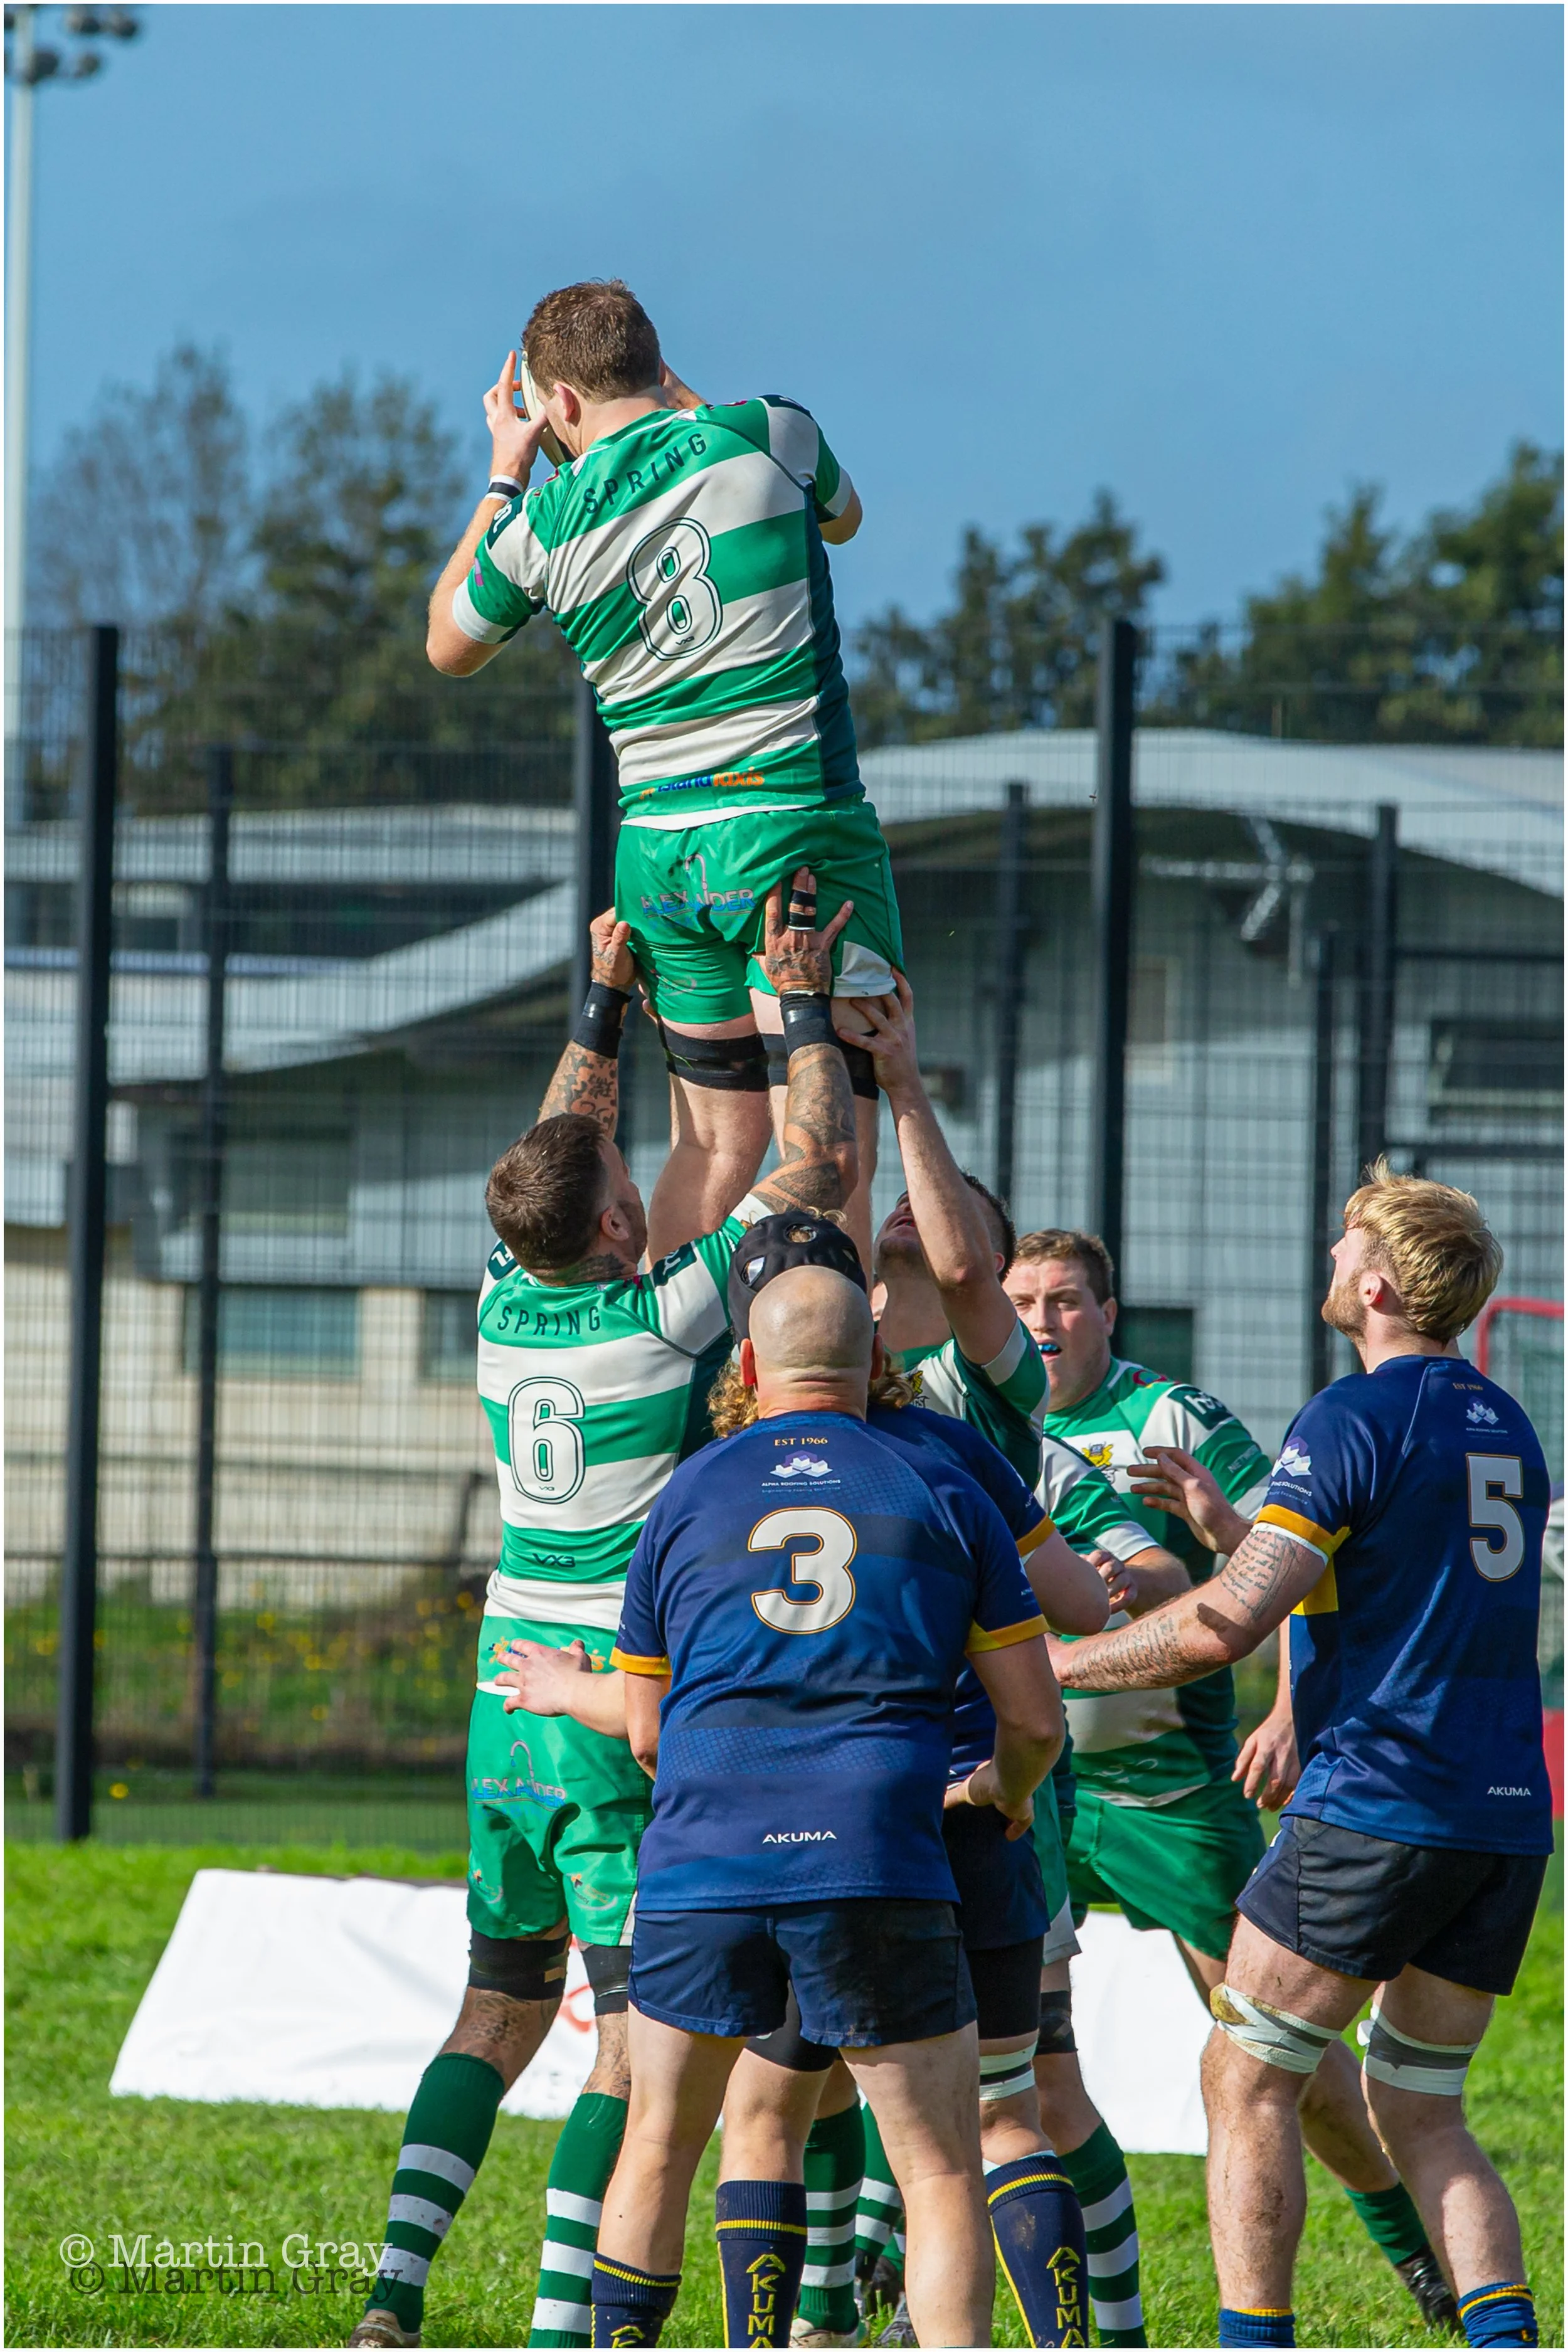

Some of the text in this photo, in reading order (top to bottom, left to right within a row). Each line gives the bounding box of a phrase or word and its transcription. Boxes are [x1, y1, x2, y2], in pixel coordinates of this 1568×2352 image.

[583, 433, 707, 514] SPRING
[628, 517, 723, 661] 8
[497, 1306, 600, 1335] SPRING
[508, 1376, 586, 1505] 6
[775, 1437, 828, 1446] EST 1966
[532, 1553, 576, 1568] VX3
[1465, 1453, 1525, 1582] 5
[748, 1507, 857, 1634] 3
[1487, 1786, 1532, 1796] AKUMA
[762, 1831, 837, 1844] AKUMA
[746, 2254, 786, 2348] AKUMA
[1046, 2247, 1085, 2348] AKUMA
